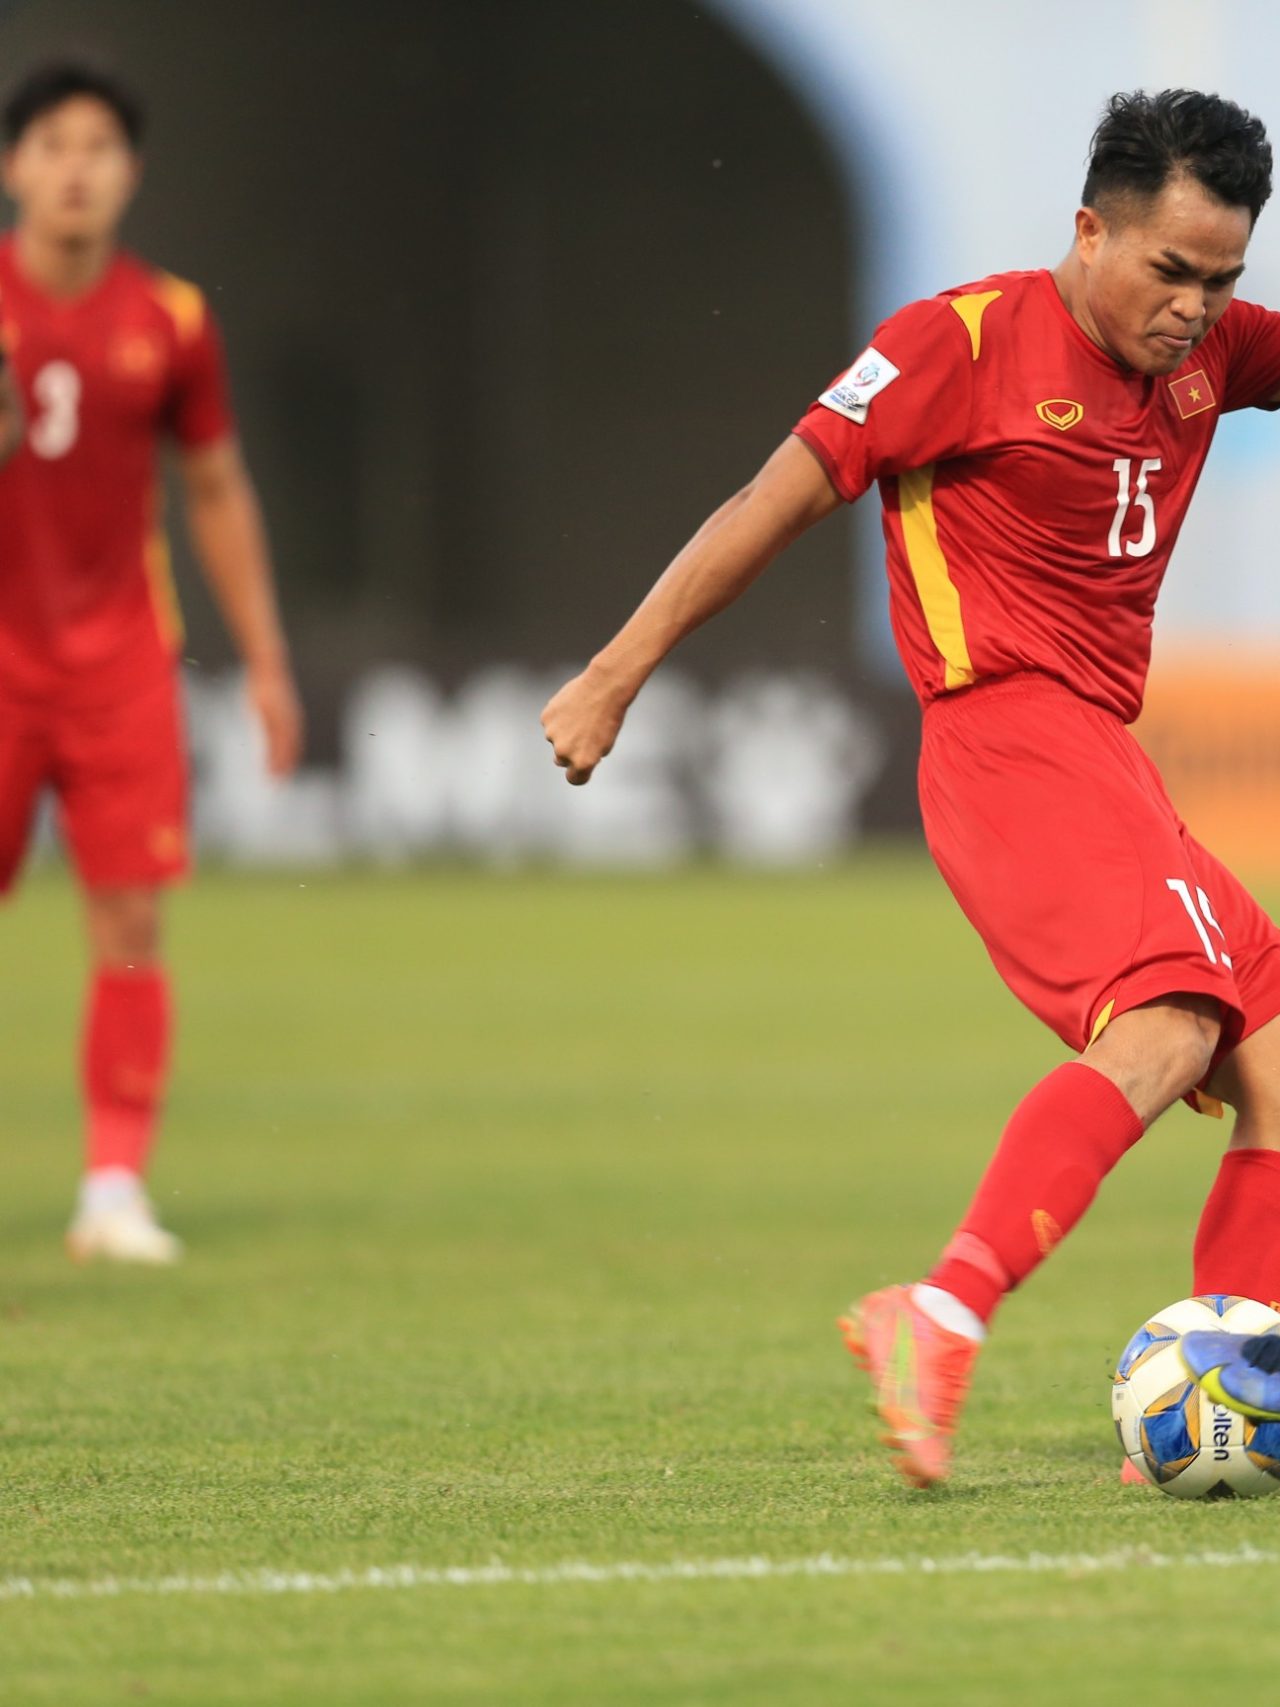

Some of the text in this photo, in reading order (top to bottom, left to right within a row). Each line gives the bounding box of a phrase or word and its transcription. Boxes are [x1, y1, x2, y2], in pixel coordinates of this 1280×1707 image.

[31, 361, 81, 459] 3
[1108, 458, 1162, 557] 15
[1212, 1403, 1232, 1462] olten
